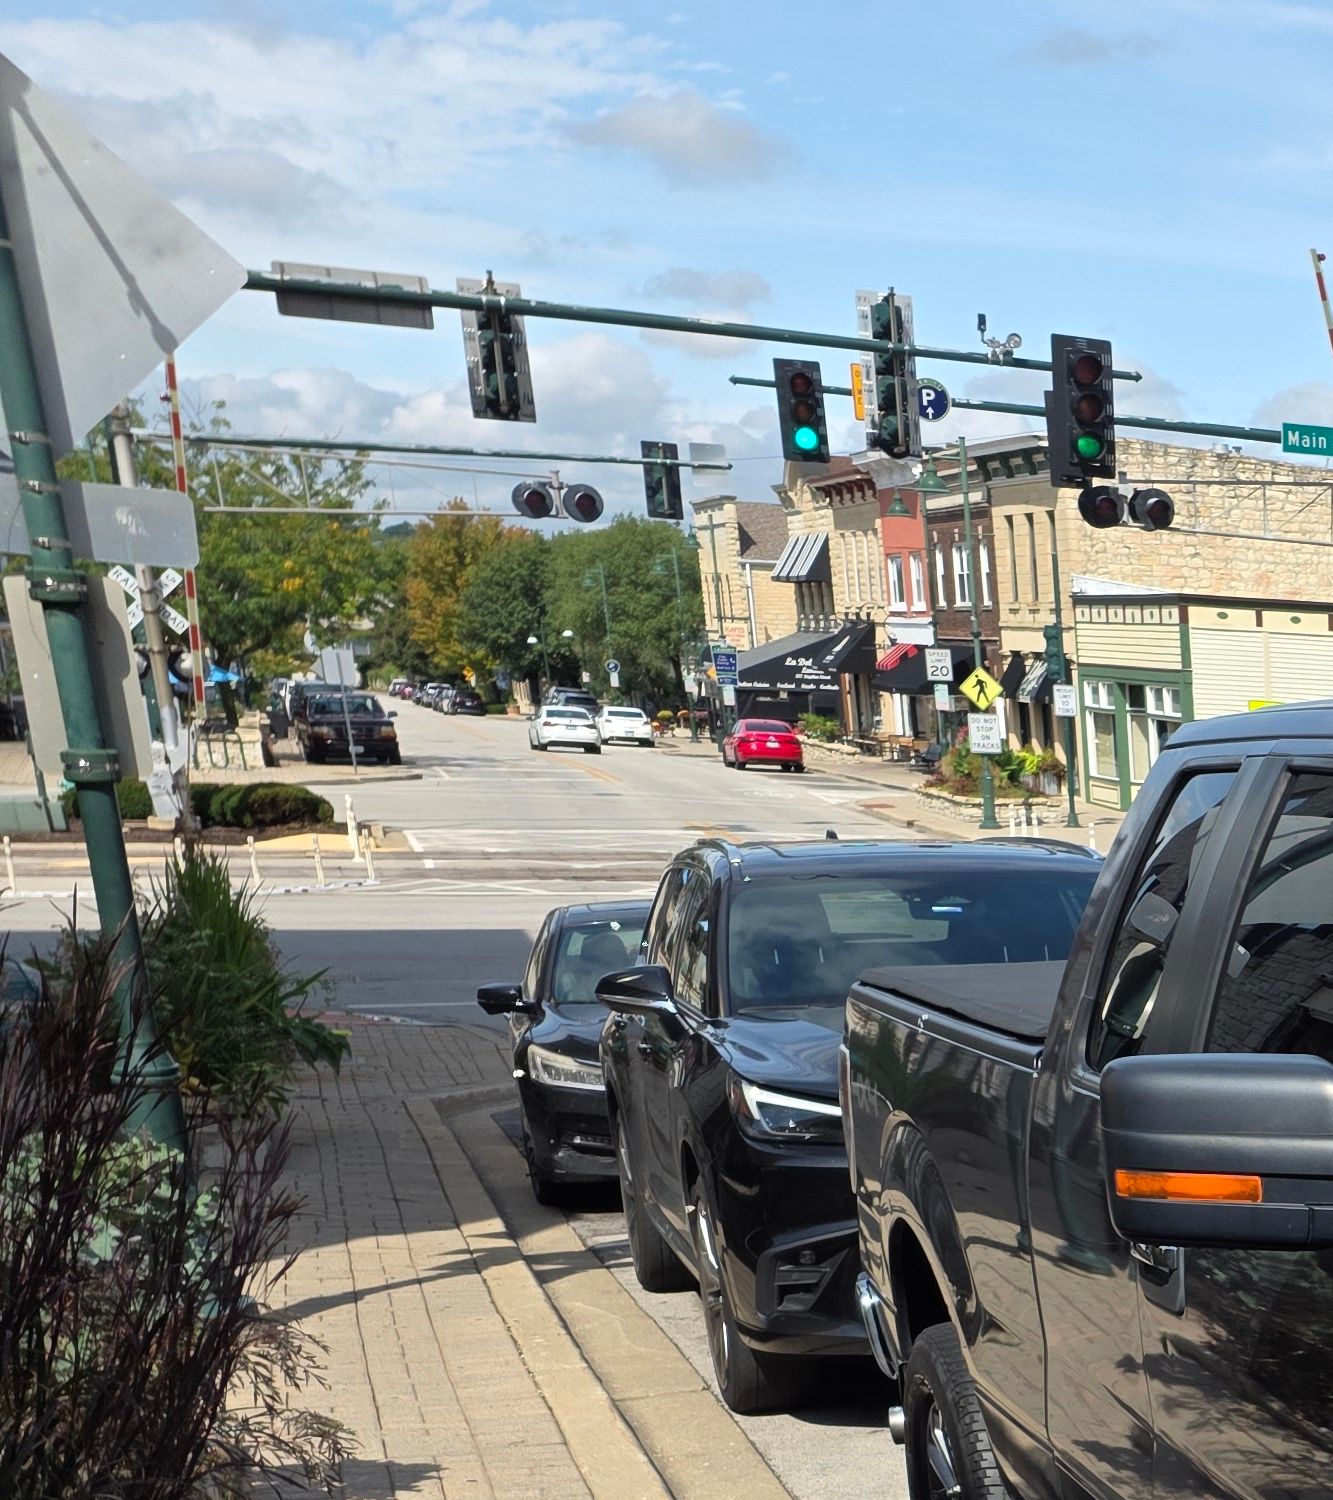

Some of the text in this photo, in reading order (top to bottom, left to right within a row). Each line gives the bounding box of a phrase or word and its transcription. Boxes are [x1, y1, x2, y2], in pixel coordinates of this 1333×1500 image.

[1287, 430, 1327, 449] Main
[930, 665, 950, 677] 20
[972, 742, 1000, 750] TRACKS
